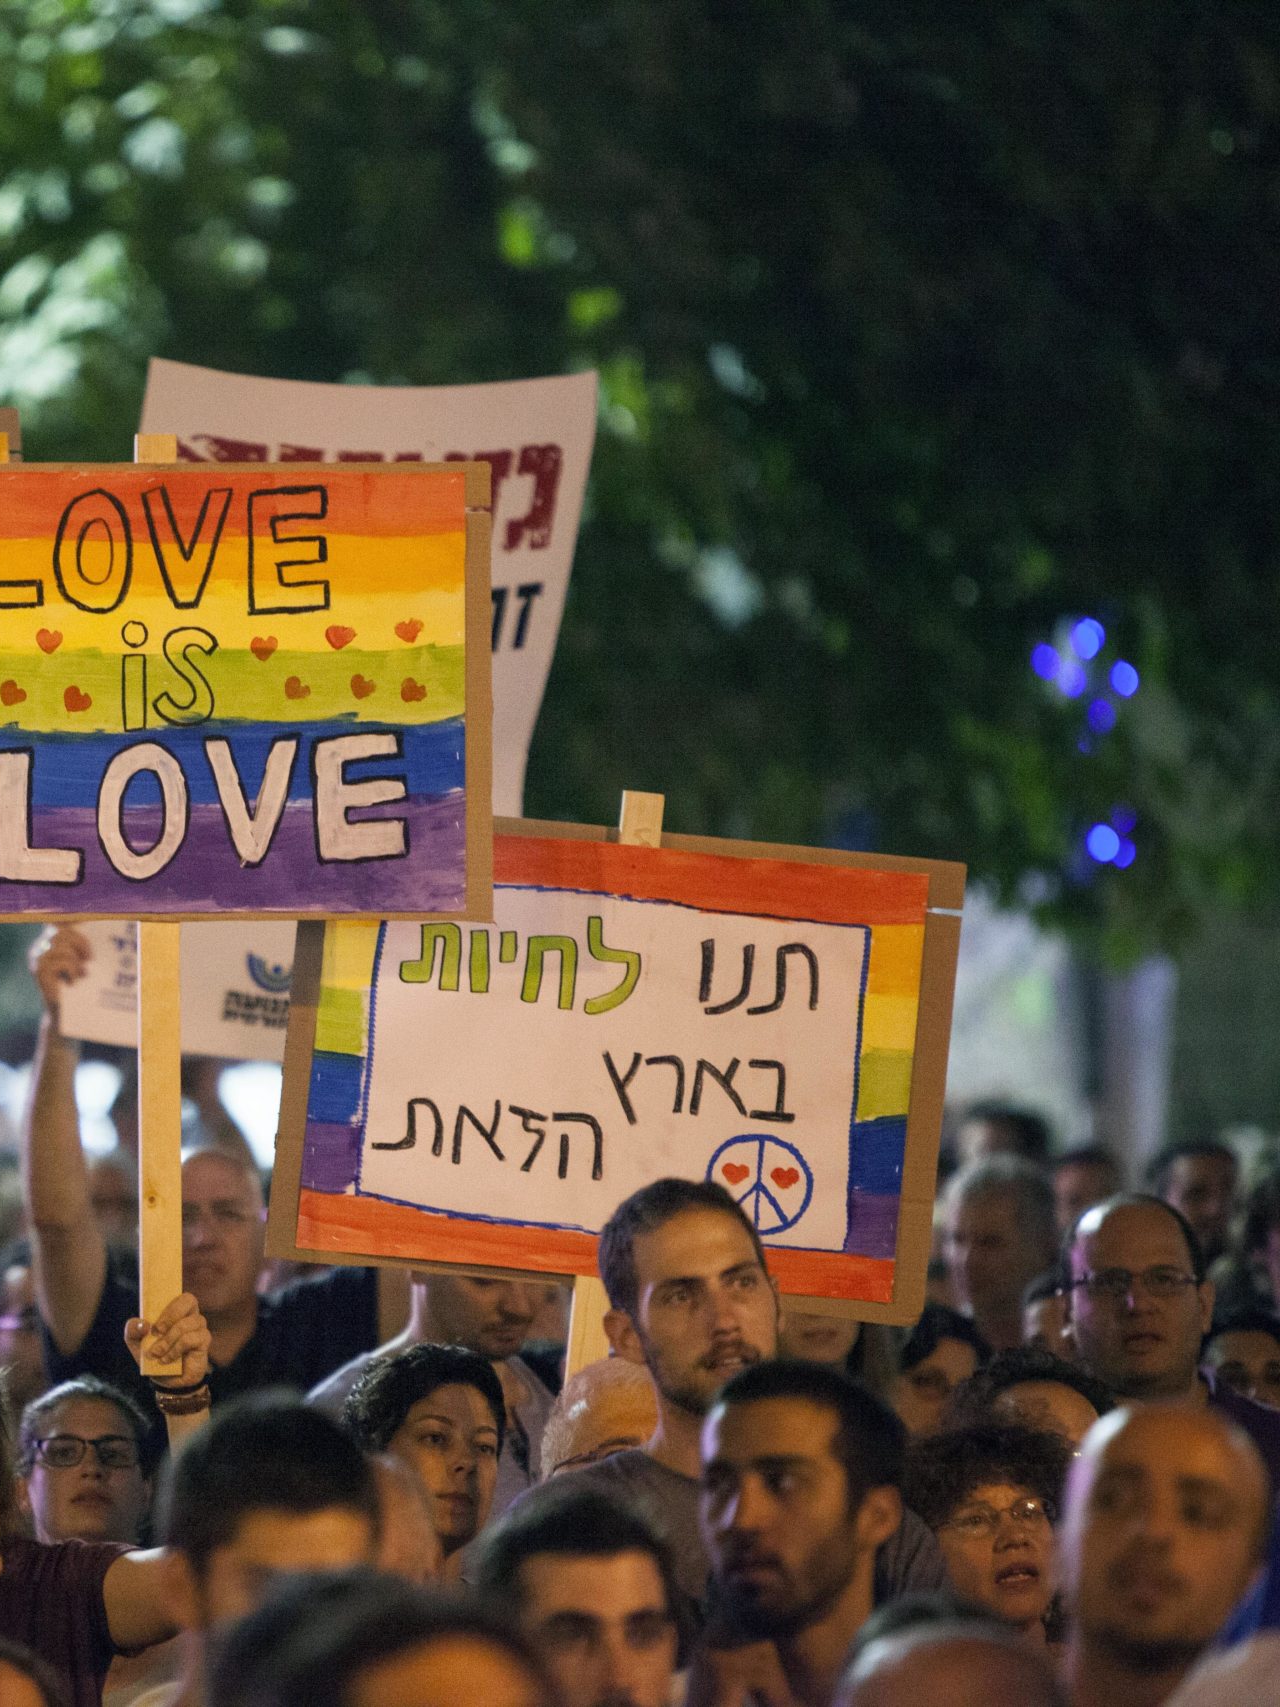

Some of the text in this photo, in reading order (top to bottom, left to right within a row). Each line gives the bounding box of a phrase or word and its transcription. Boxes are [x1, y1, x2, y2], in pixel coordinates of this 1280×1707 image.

[398, 915, 820, 1016] תנו לחיות
[603, 1050, 795, 1126] בארץ
[371, 1097, 604, 1181] הזאת
